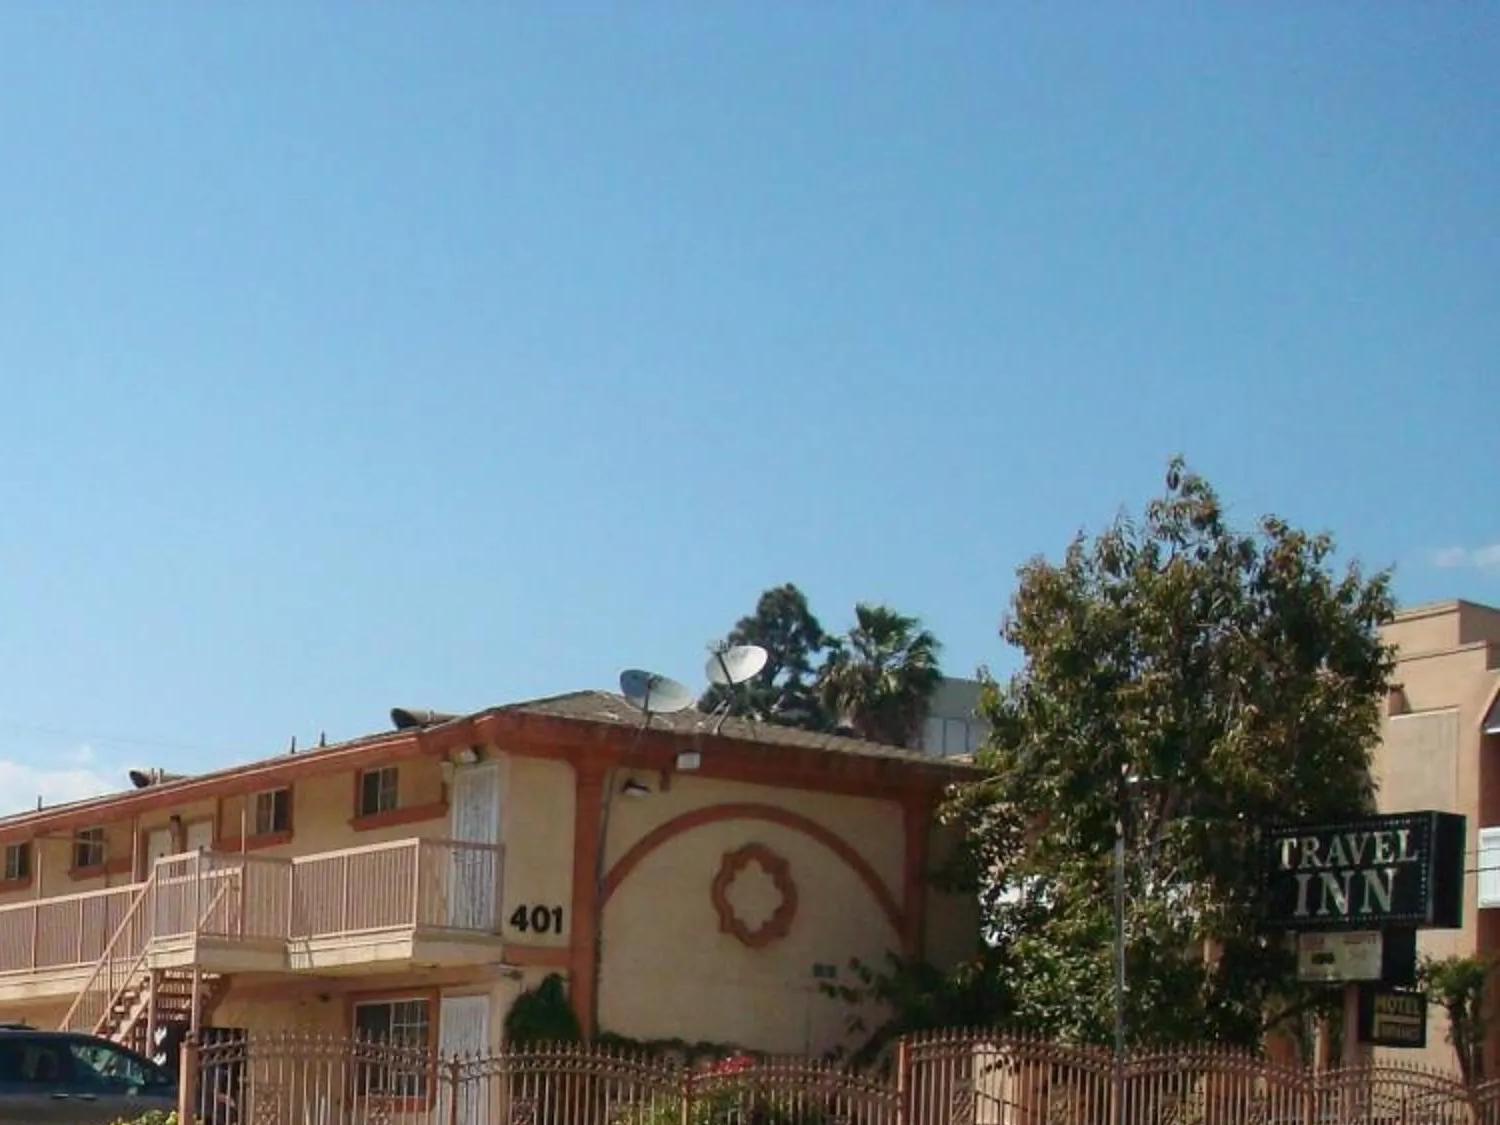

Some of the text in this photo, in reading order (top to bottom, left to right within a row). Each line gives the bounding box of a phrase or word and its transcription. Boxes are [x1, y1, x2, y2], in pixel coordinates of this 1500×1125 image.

[1275, 829, 1419, 870] TRAVEL
[1294, 868, 1397, 917] INN
[509, 904, 563, 935] 401
